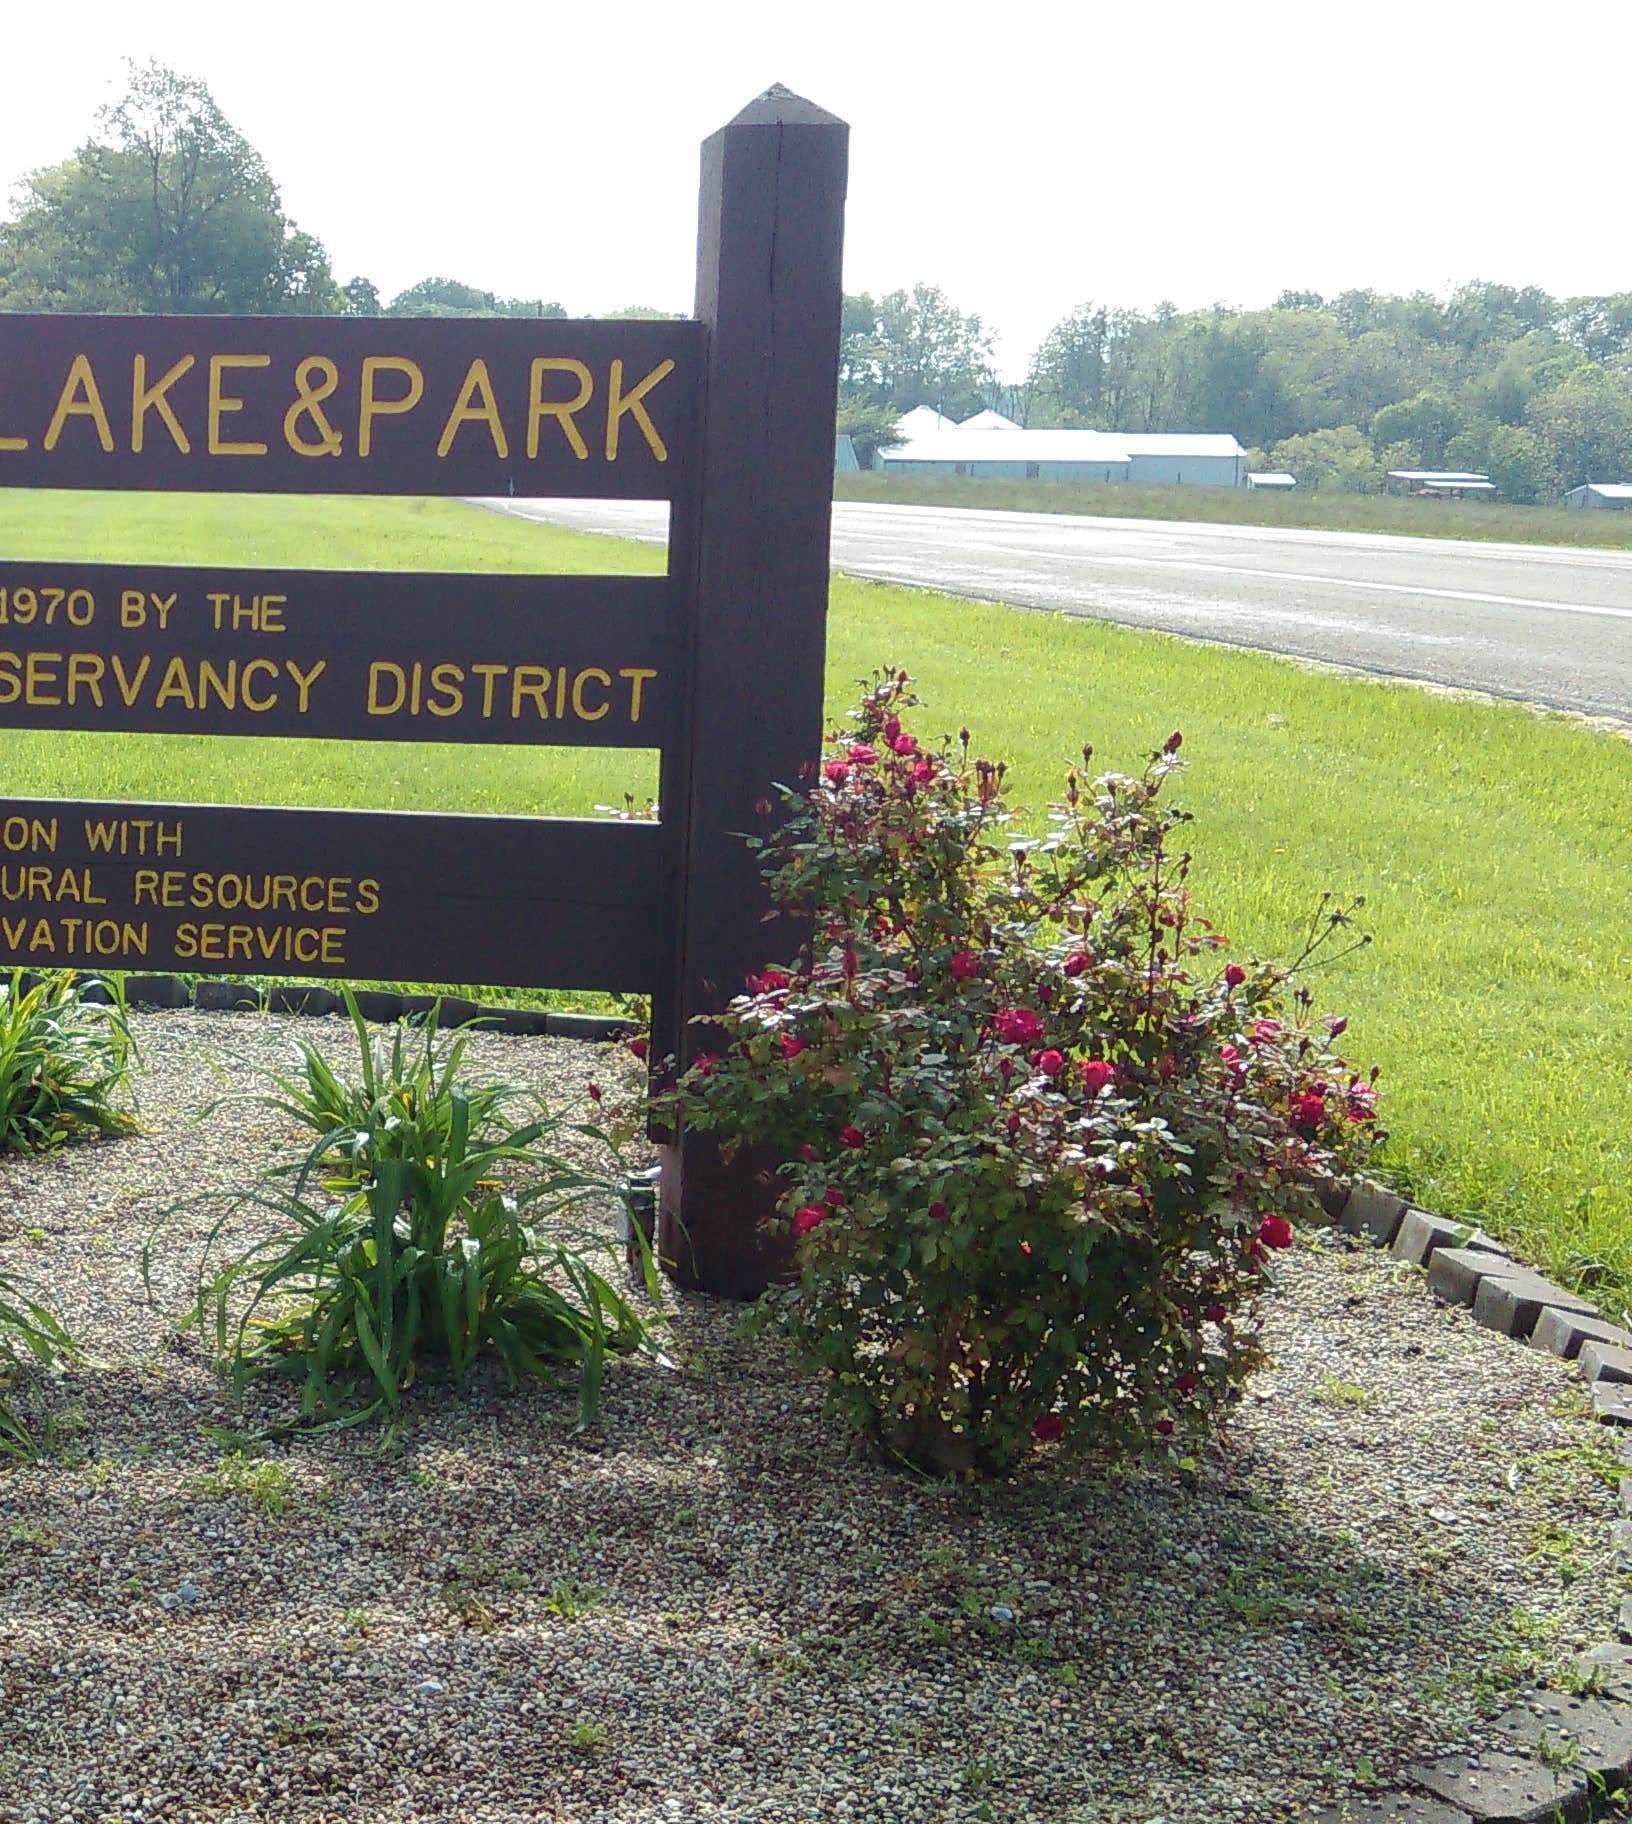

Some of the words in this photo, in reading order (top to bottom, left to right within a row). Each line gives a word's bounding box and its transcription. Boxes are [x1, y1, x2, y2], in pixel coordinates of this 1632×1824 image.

[120, 589, 178, 631] BY
[207, 593, 288, 633] THE
[366, 661, 659, 724] DISTRICT
[84, 819, 184, 857] WITH
[134, 869, 382, 915] RESOURCES
[174, 921, 348, 964] SERVICE
